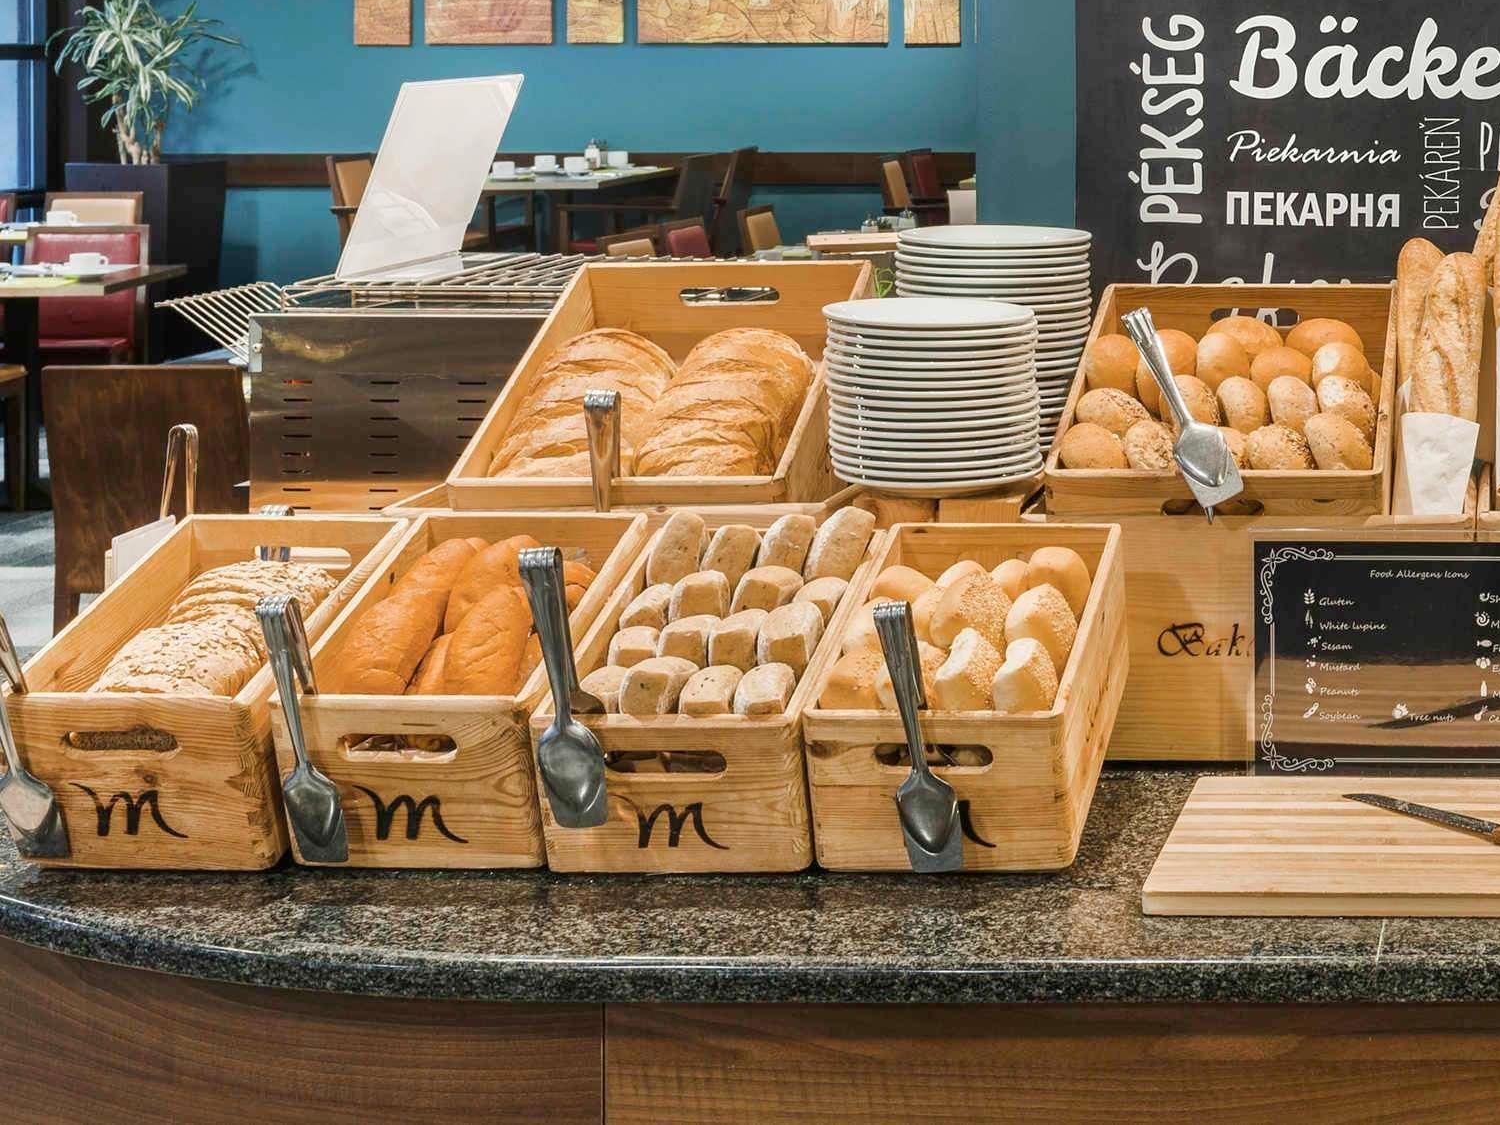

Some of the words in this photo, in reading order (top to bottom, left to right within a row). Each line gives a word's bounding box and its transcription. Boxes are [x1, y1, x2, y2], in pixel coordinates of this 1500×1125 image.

[1127, 14, 1205, 224] PÉKSÉG
[1226, 129, 1402, 165] Piekarnia
[1418, 116, 1461, 229] PEKÁREŇ
[1226, 190, 1401, 228] ПЕКАРНЯ
[1369, 569, 1394, 579] Food
[1396, 569, 1442, 581] Allergens
[1319, 596, 1355, 606] Gluten
[1319, 620, 1351, 630] White
[1320, 662, 1361, 672] Mustard
[1320, 686, 1360, 696] Peanuts
